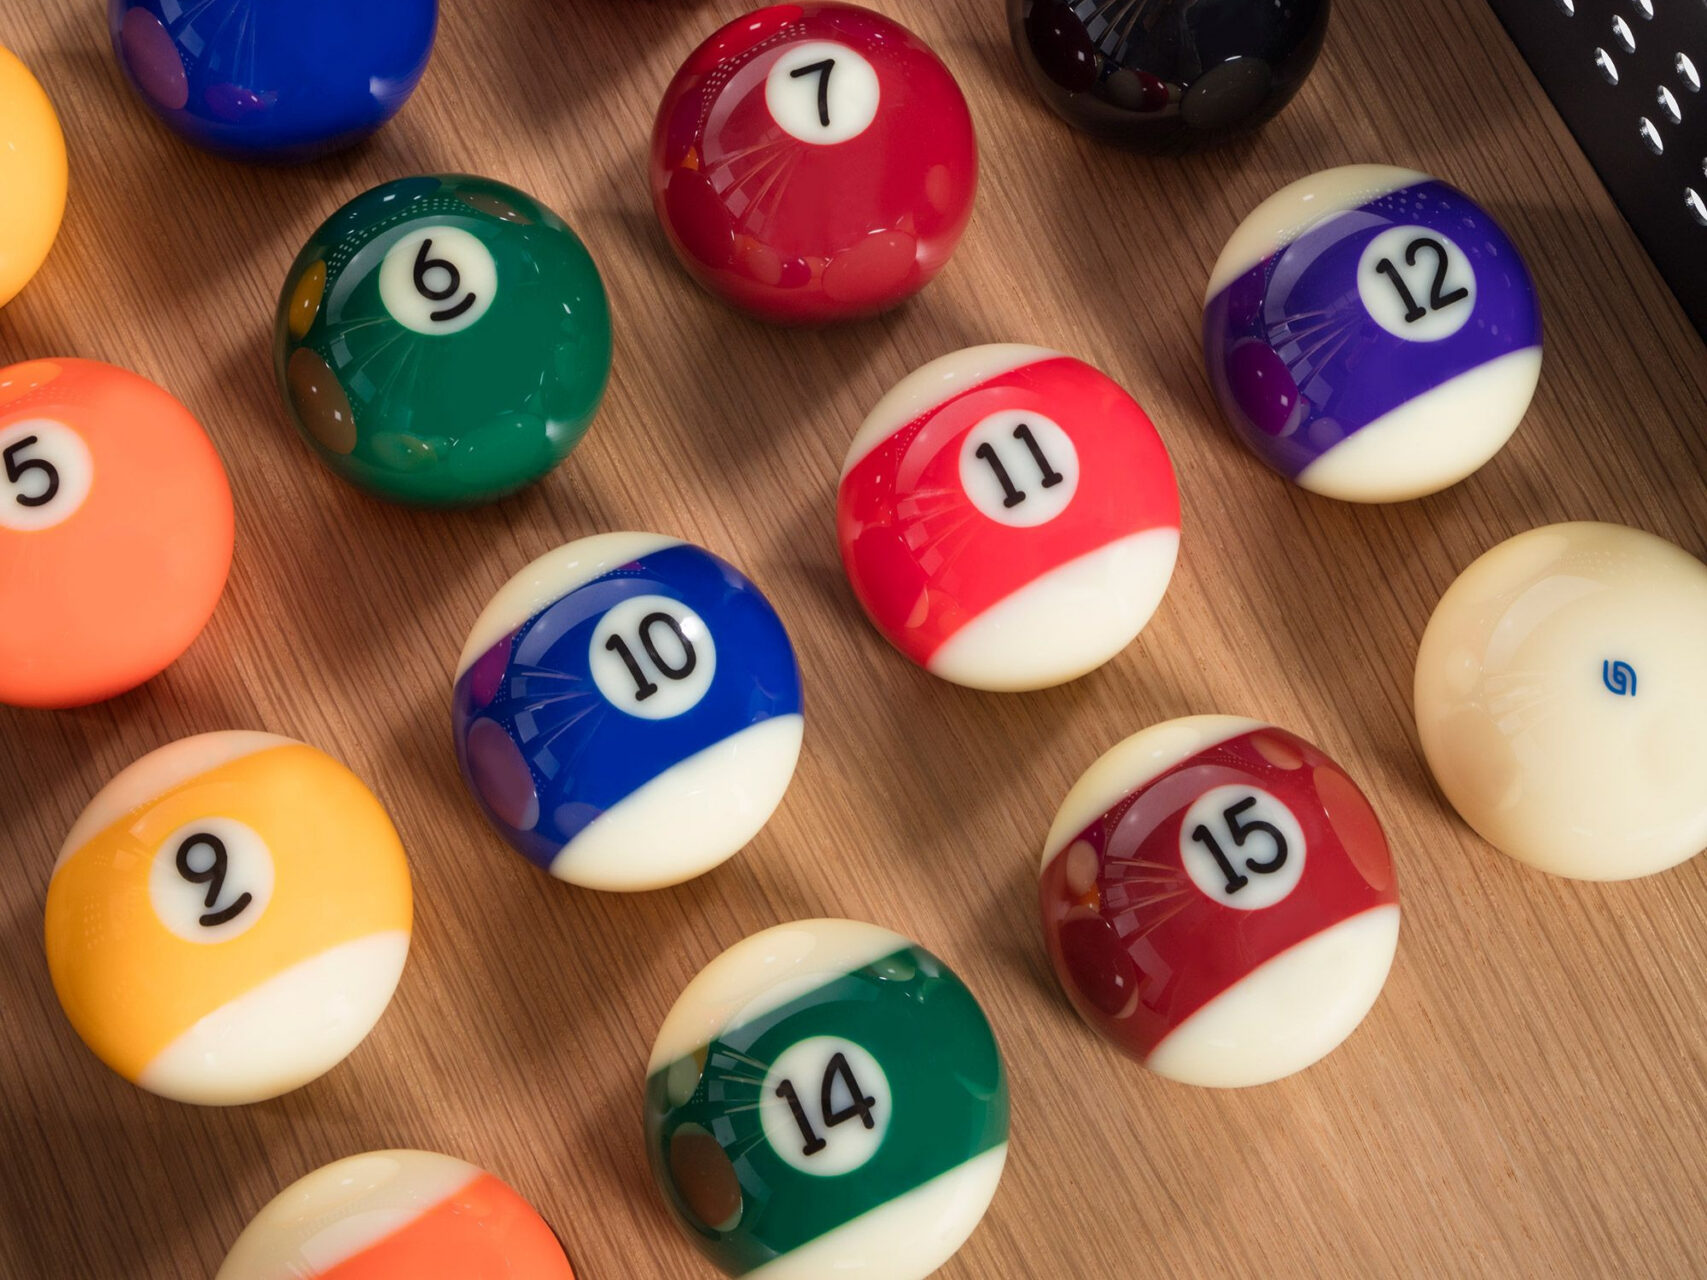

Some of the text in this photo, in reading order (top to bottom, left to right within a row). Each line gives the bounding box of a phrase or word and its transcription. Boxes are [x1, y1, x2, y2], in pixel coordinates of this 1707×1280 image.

[790, 59, 835, 127] 7
[413, 239, 476, 322] 6
[1375, 237, 1468, 323] 12
[3, 436, 59, 507] 5
[975, 424, 1063, 508] 11
[605, 612, 697, 701] 10
[176, 833, 252, 927] 9
[1190, 796, 1288, 895] 15
[775, 1052, 877, 1156] 14
